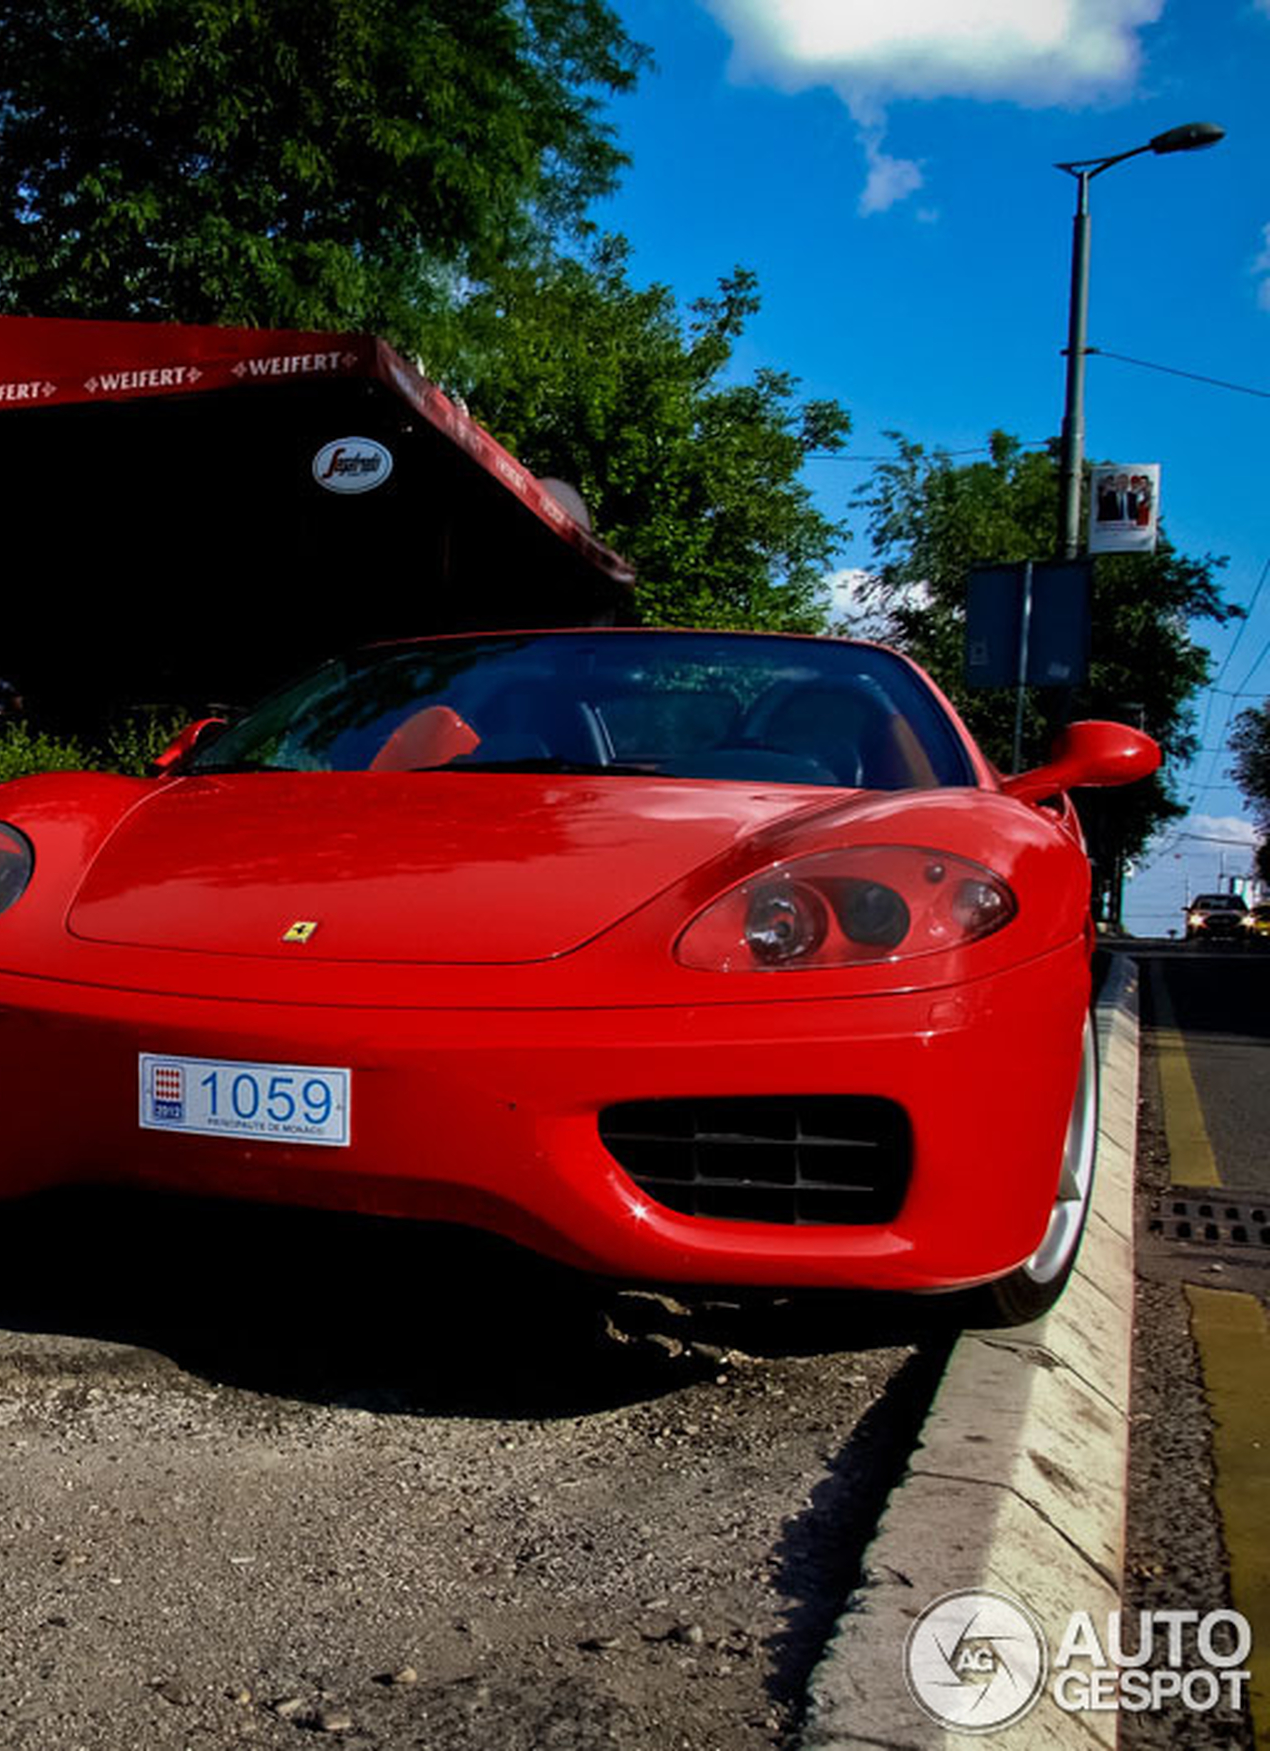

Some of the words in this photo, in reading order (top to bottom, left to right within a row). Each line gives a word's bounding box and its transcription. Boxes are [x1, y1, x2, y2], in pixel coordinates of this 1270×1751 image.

[249, 351, 342, 376] WEIFERT
[99, 367, 187, 391] WEIFERT
[200, 1071, 332, 1125] 1059
[268, 1122, 282, 1133] DE
